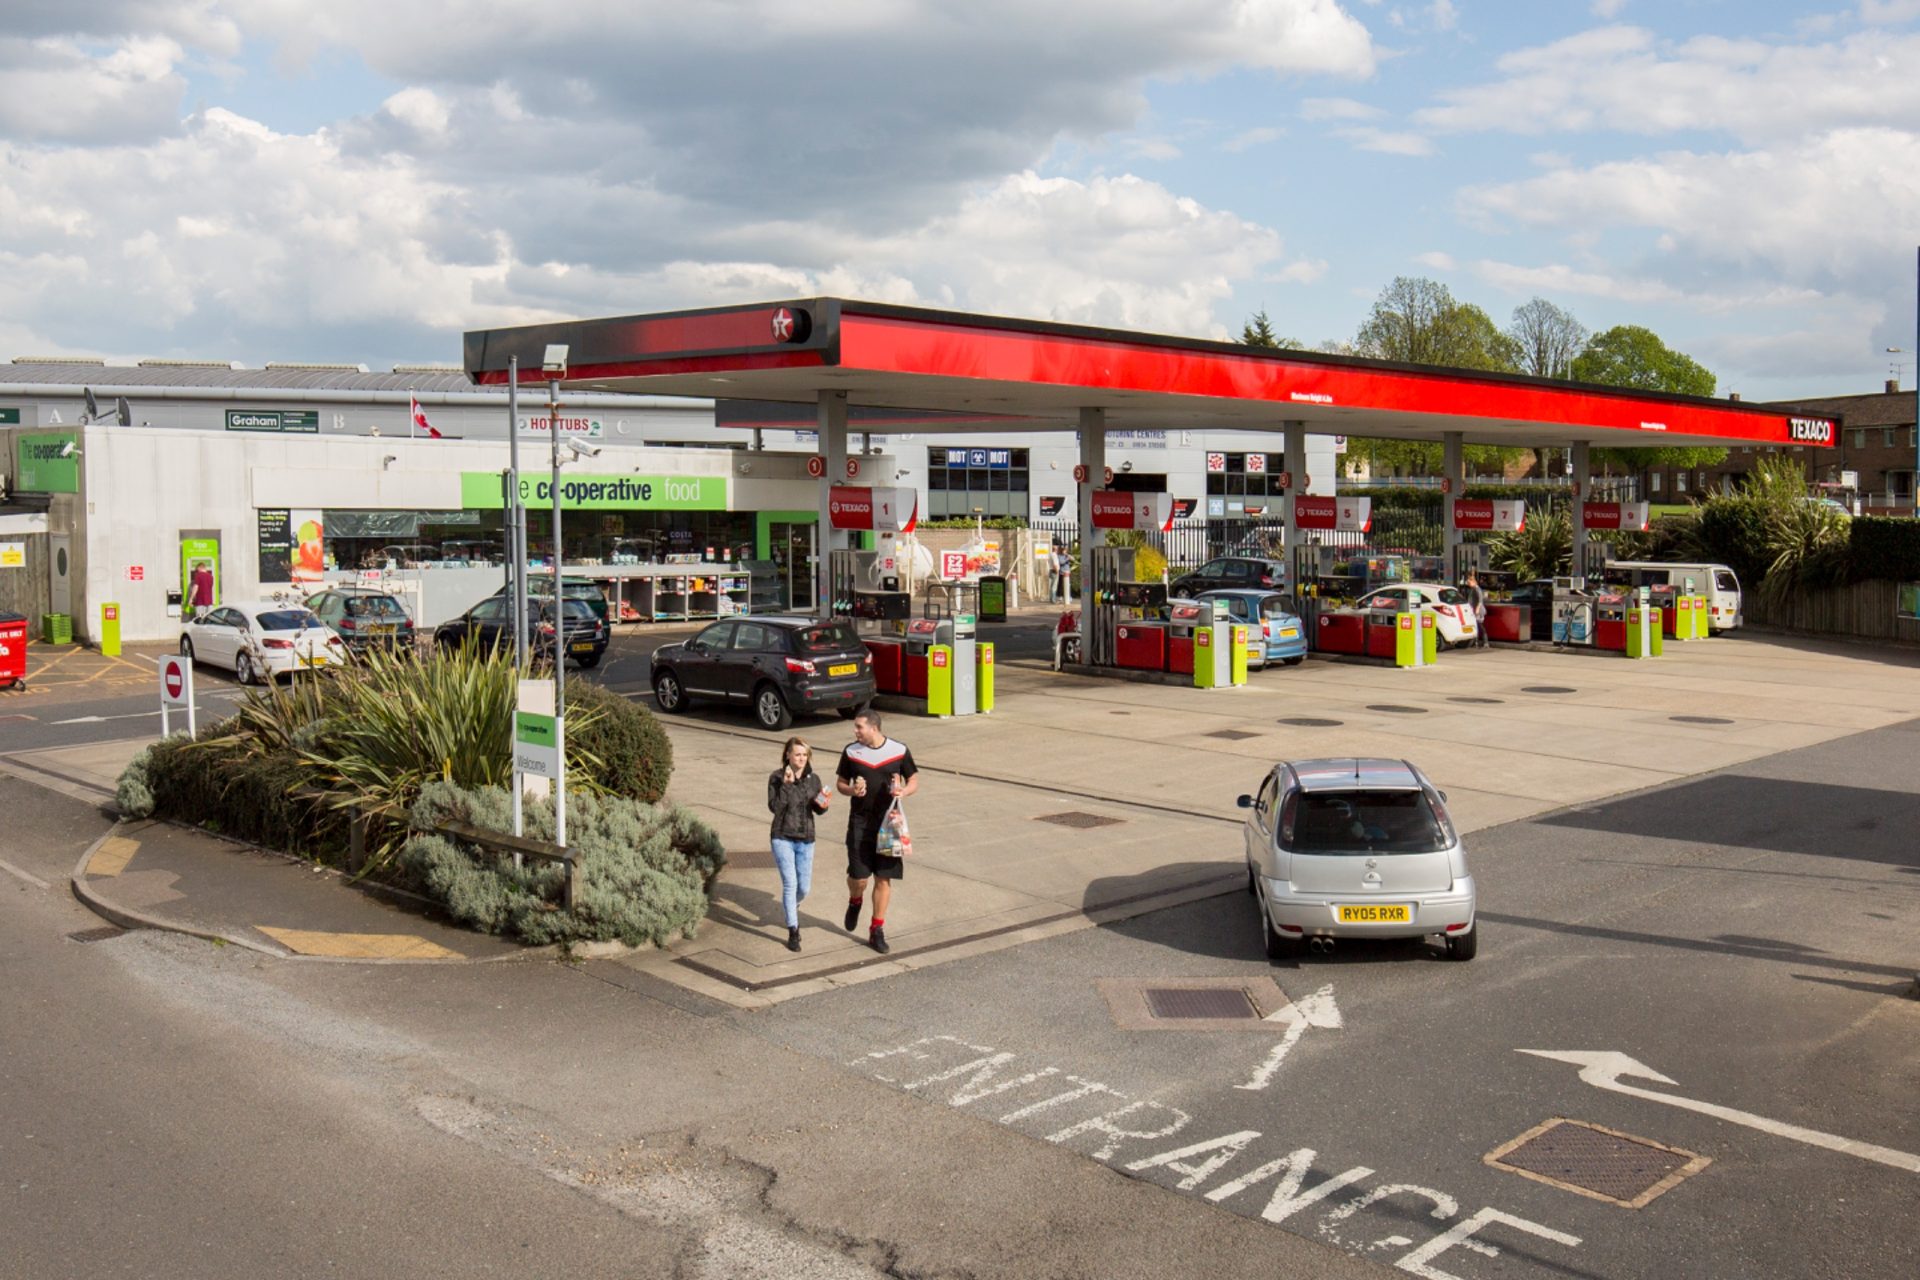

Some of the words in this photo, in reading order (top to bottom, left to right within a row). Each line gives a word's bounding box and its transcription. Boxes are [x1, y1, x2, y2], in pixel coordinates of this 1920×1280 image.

[49, 409, 63, 424] A
[232, 414, 278, 427] Graham
[531, 418, 554, 430] HOT
[559, 419, 589, 431] TUBS
[1790, 417, 1831, 442] TEXACO
[948, 451, 966, 464] MOT
[989, 452, 1008, 464] MOT
[848, 462, 857, 473] 2
[664, 478, 700, 502] food
[841, 503, 869, 513] TEXACO
[882, 502, 889, 516] 1
[1103, 506, 1132, 515] TEXACO
[1142, 505, 1150, 517] 3
[1306, 508, 1334, 517] TEXACO
[1344, 508, 1351, 519] 5
[1464, 510, 1492, 519] TEXACO
[1501, 510, 1508, 520] 7
[1593, 511, 1618, 519] TEXACO
[670, 531, 693, 539] COSTA
[948, 555, 963, 567] £2
[517, 755, 546, 773] Welcome
[1343, 907, 1377, 920] RY05
[1379, 907, 1404, 920] RXR
[849, 1034, 1583, 1280] ENTRANCE
